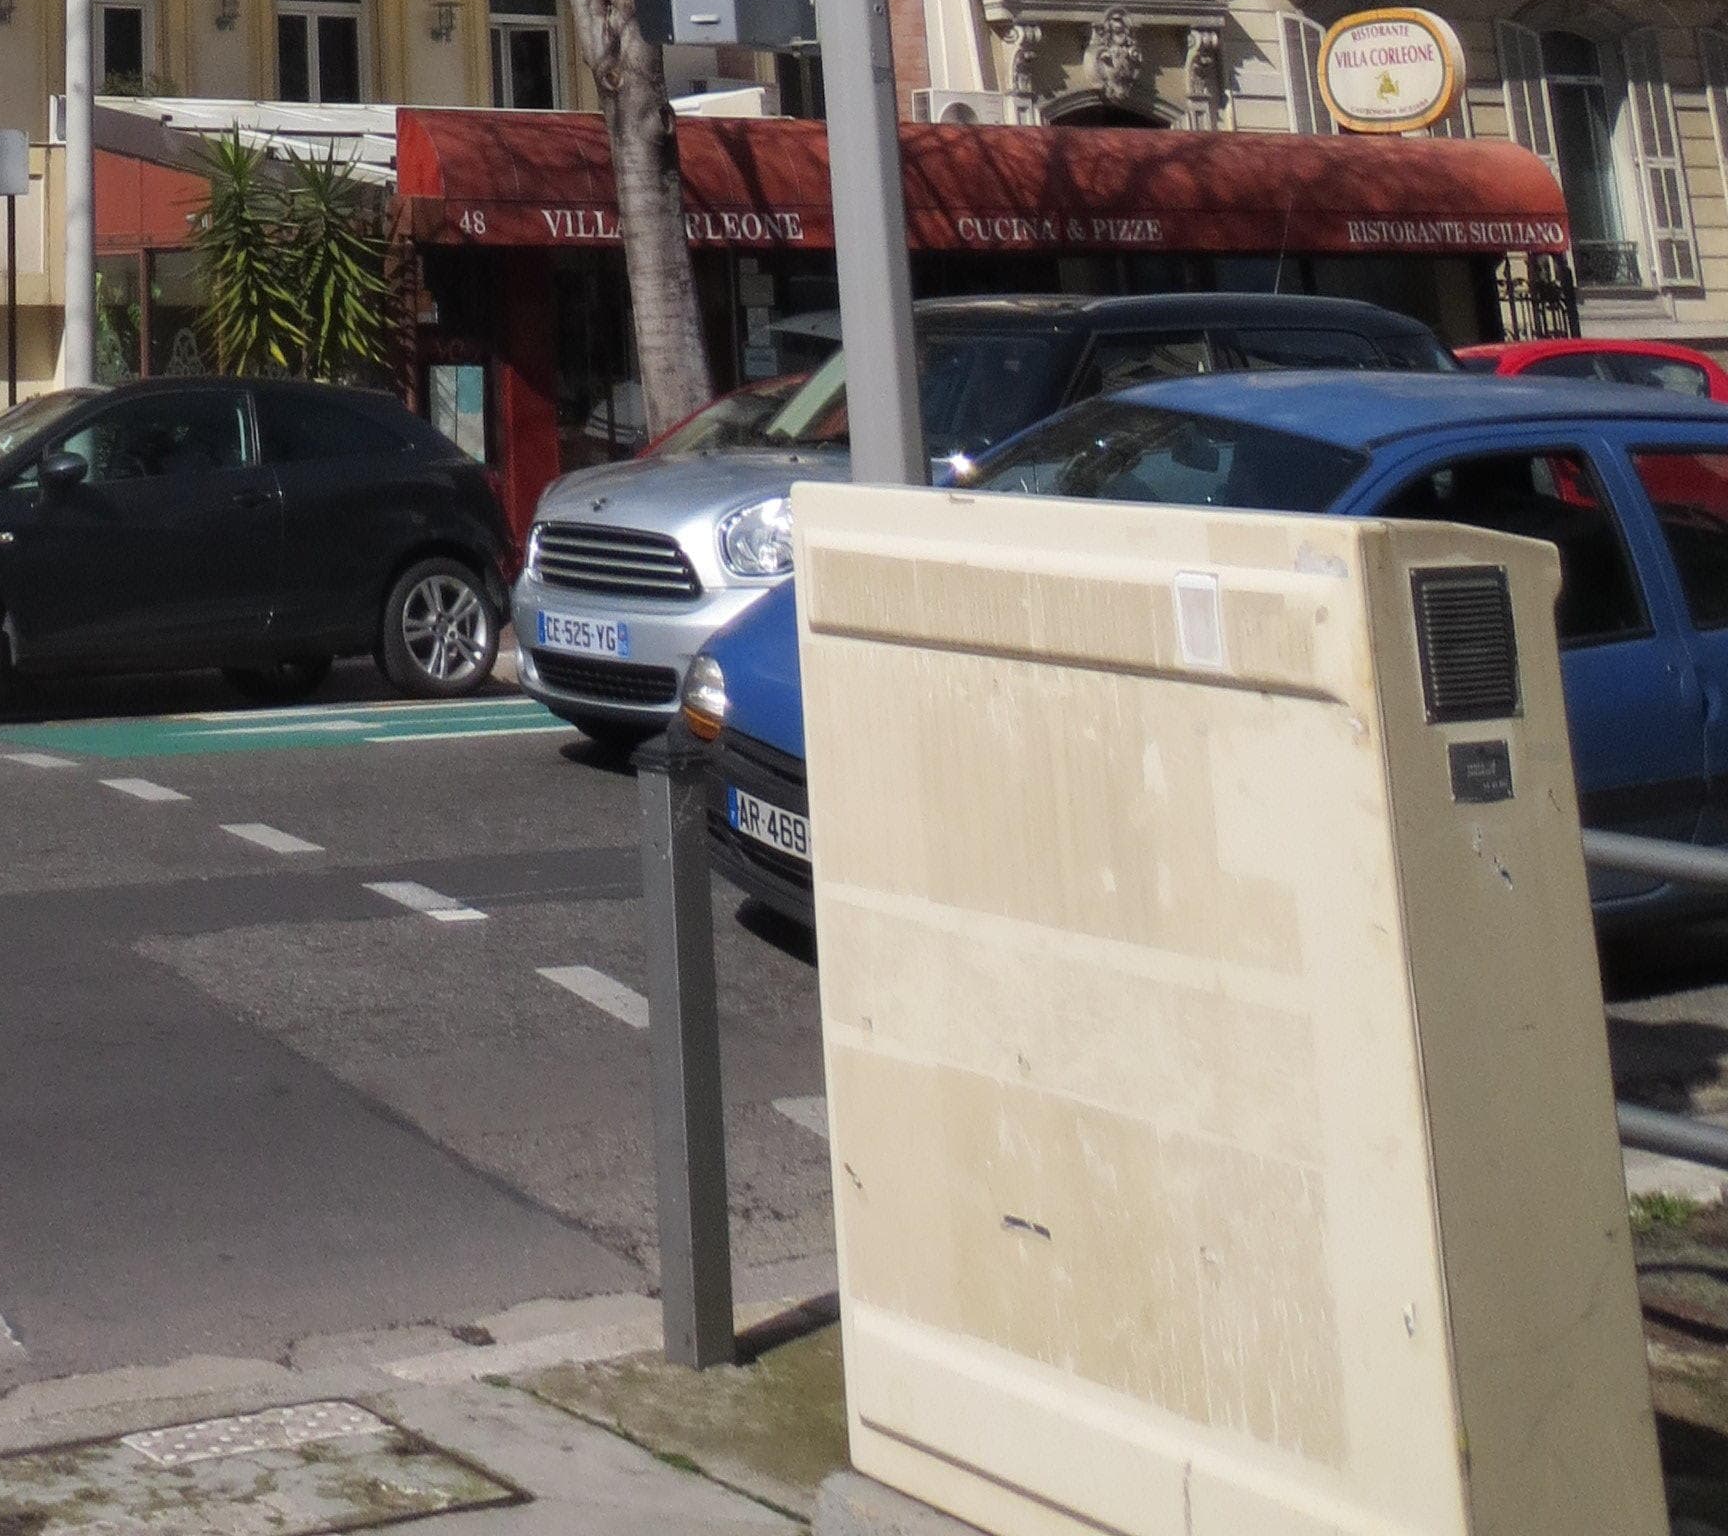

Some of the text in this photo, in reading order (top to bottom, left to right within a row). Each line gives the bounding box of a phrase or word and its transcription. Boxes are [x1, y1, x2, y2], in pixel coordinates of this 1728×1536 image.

[1351, 25, 1409, 42] RISTORANTE
[1335, 43, 1435, 69] VILLA CORLEONE
[459, 209, 486, 235] 48
[684, 211, 804, 241] RLEONE
[958, 217, 1164, 242] CUCINA & PIZZE
[1347, 221, 1564, 244] RISTORANTE SICILIANO
[546, 616, 616, 651] CE-525-YG
